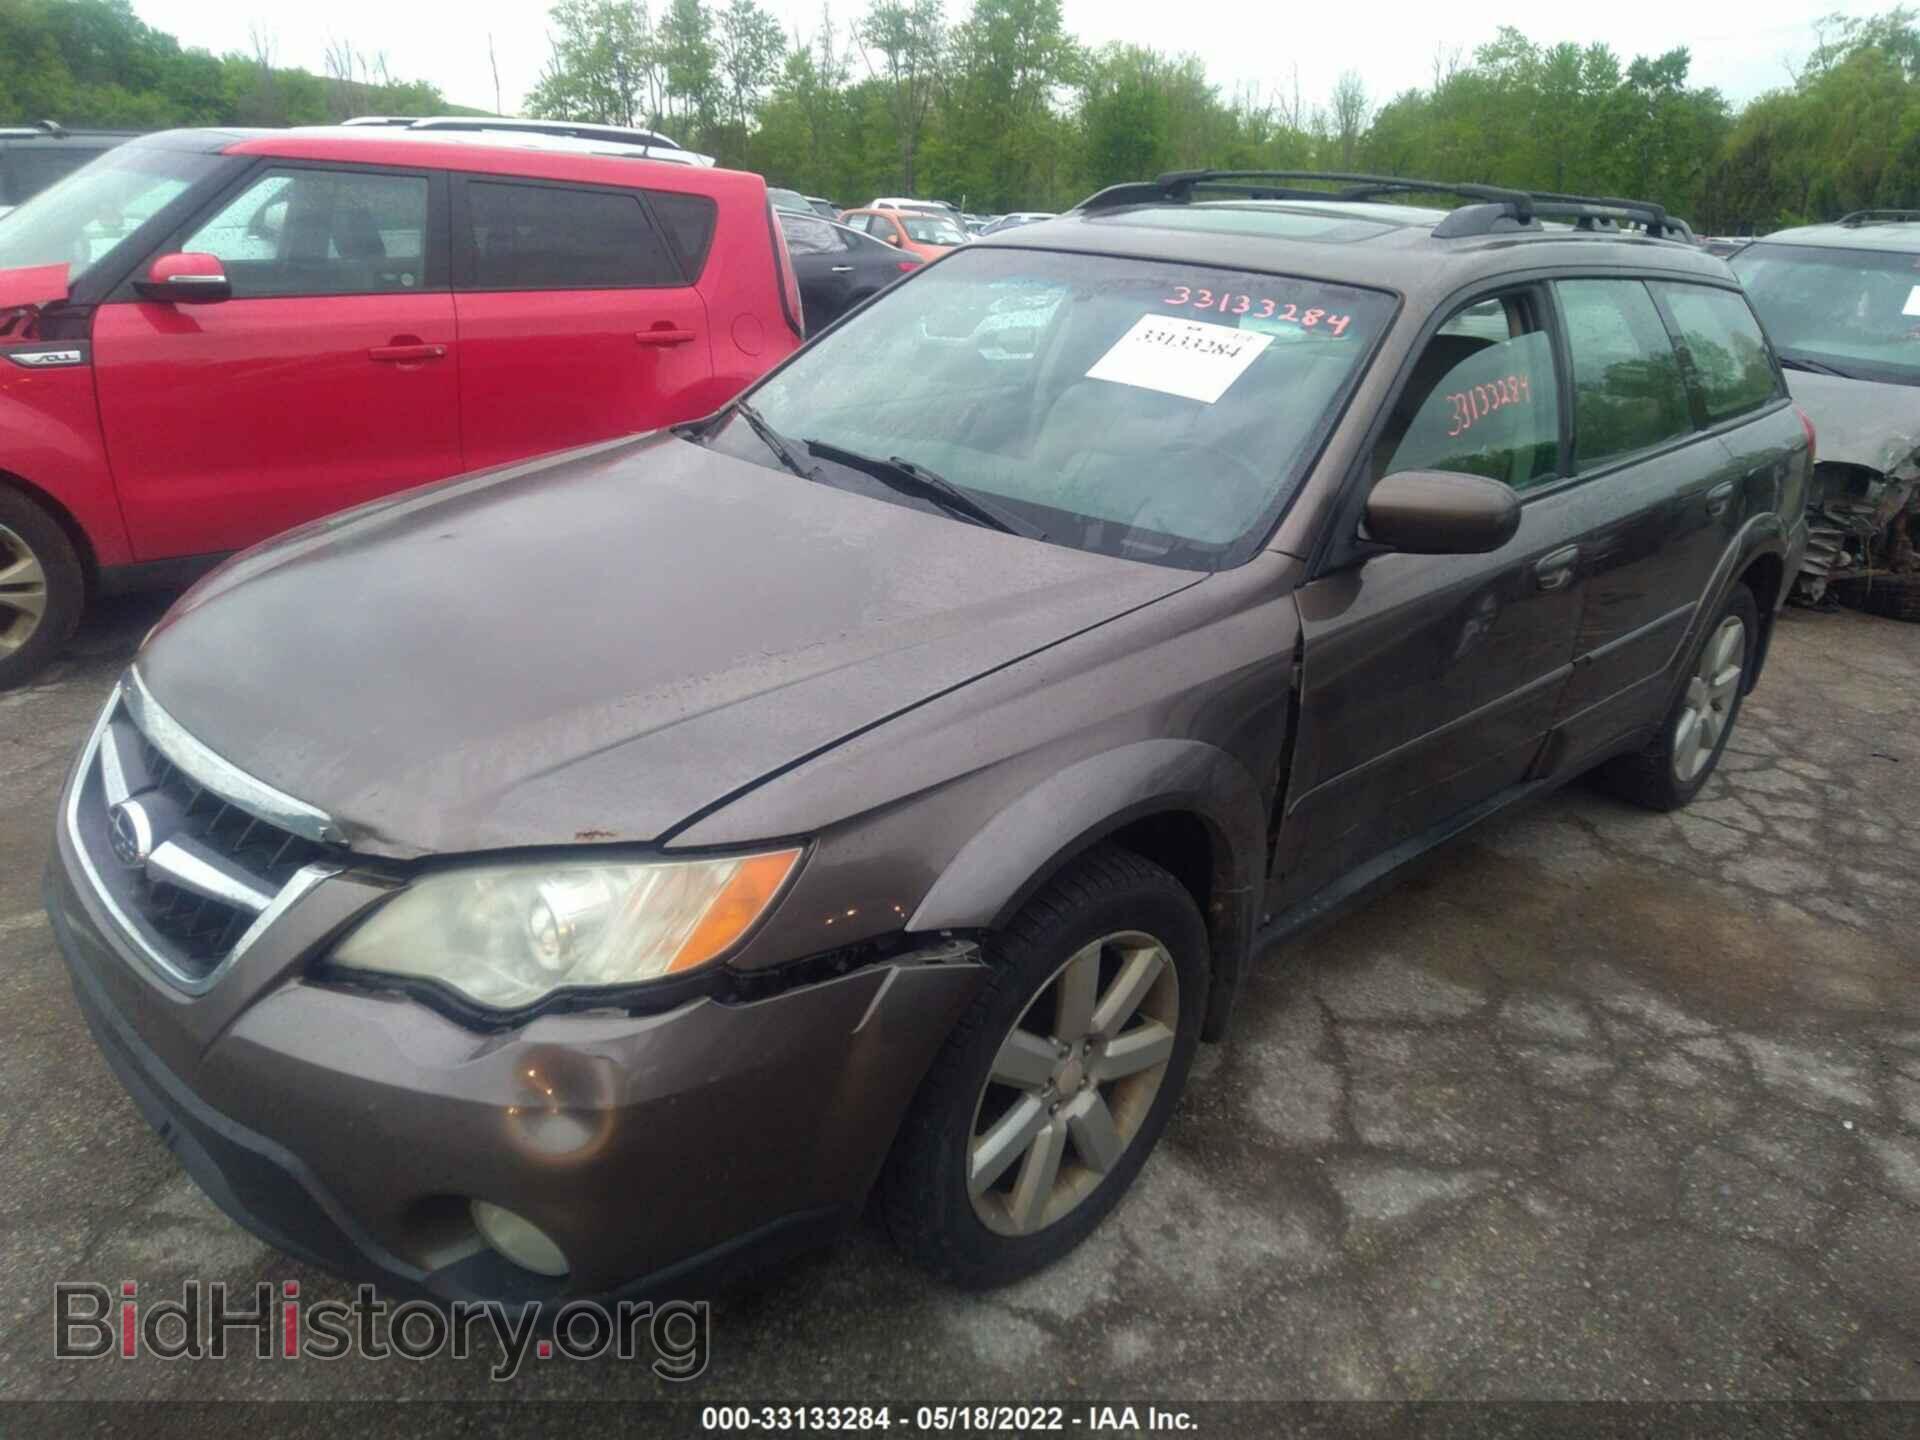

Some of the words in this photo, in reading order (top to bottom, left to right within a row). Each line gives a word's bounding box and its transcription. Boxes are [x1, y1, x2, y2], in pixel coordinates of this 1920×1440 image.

[1165, 286, 1350, 335] 33133284
[1136, 328, 1242, 359] 33133284
[1445, 375, 1531, 436] 33133284
